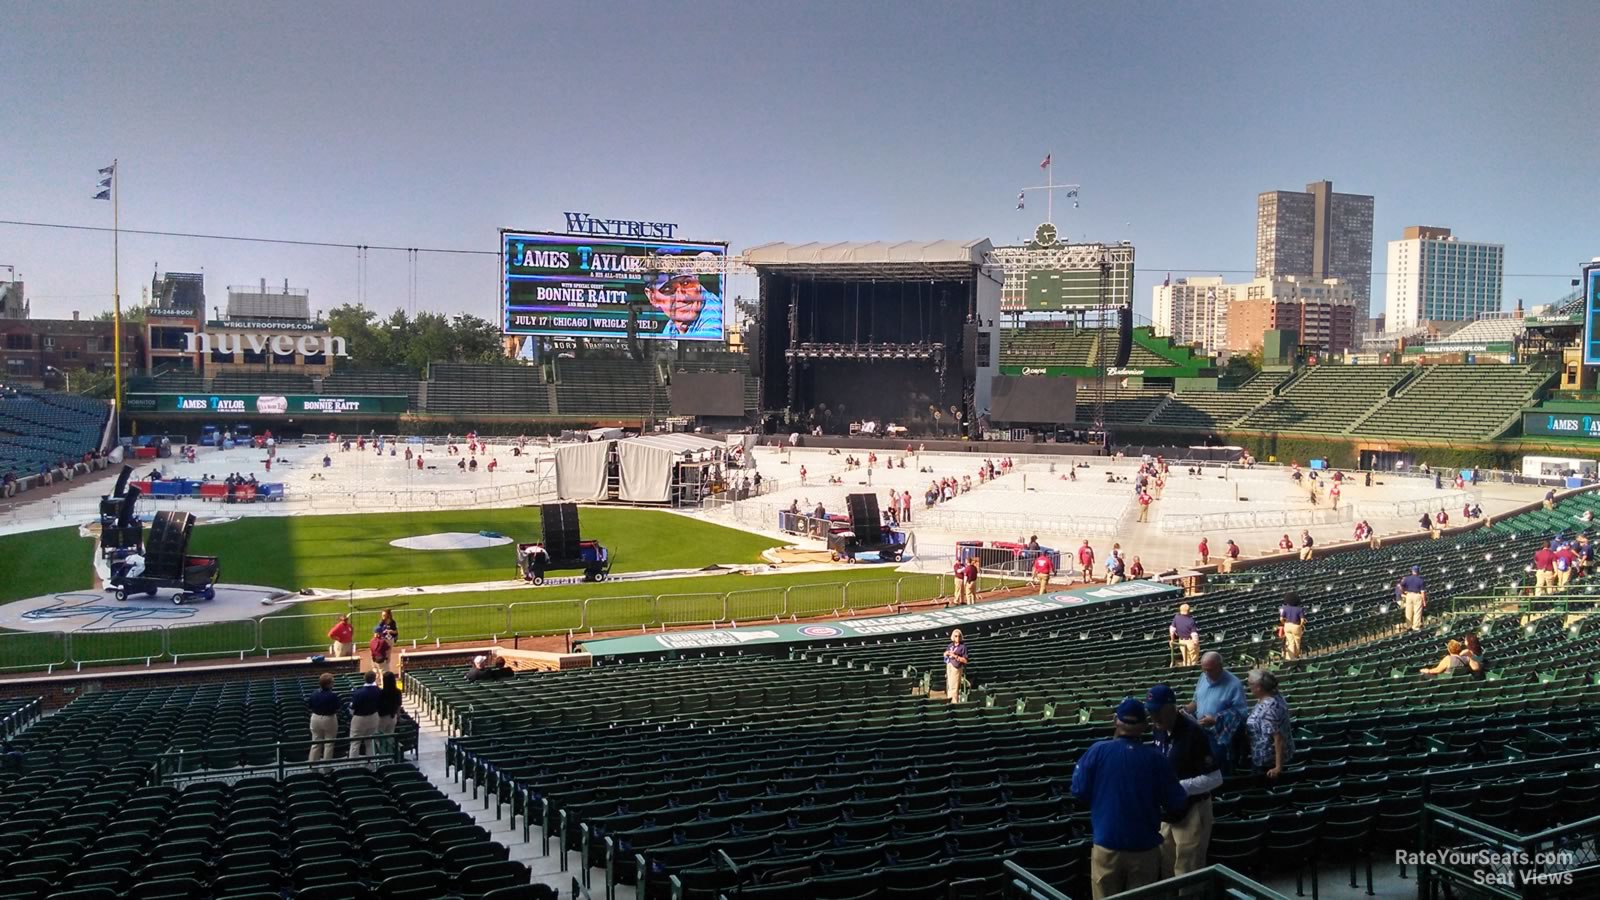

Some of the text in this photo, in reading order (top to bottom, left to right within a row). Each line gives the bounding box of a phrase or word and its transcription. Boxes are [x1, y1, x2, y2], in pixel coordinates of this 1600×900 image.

[563, 212, 679, 239] WINTRUST
[513, 243, 644, 273] JAMES TAYLOR
[537, 286, 628, 304] BONNIE RAITT
[223, 321, 314, 331] WRIGLEYROOFTOPS.COM
[515, 315, 537, 326] JULY
[539, 316, 548, 326] 17
[553, 316, 588, 328] CHICAGO
[594, 318, 629, 329] WRIGLE
[184, 332, 349, 357] nuveen
[177, 396, 208, 409] JAMES
[210, 396, 245, 409] TAYLOR
[303, 401, 360, 410] BONNIE RAITT
[1547, 415, 1579, 431] JAMES
